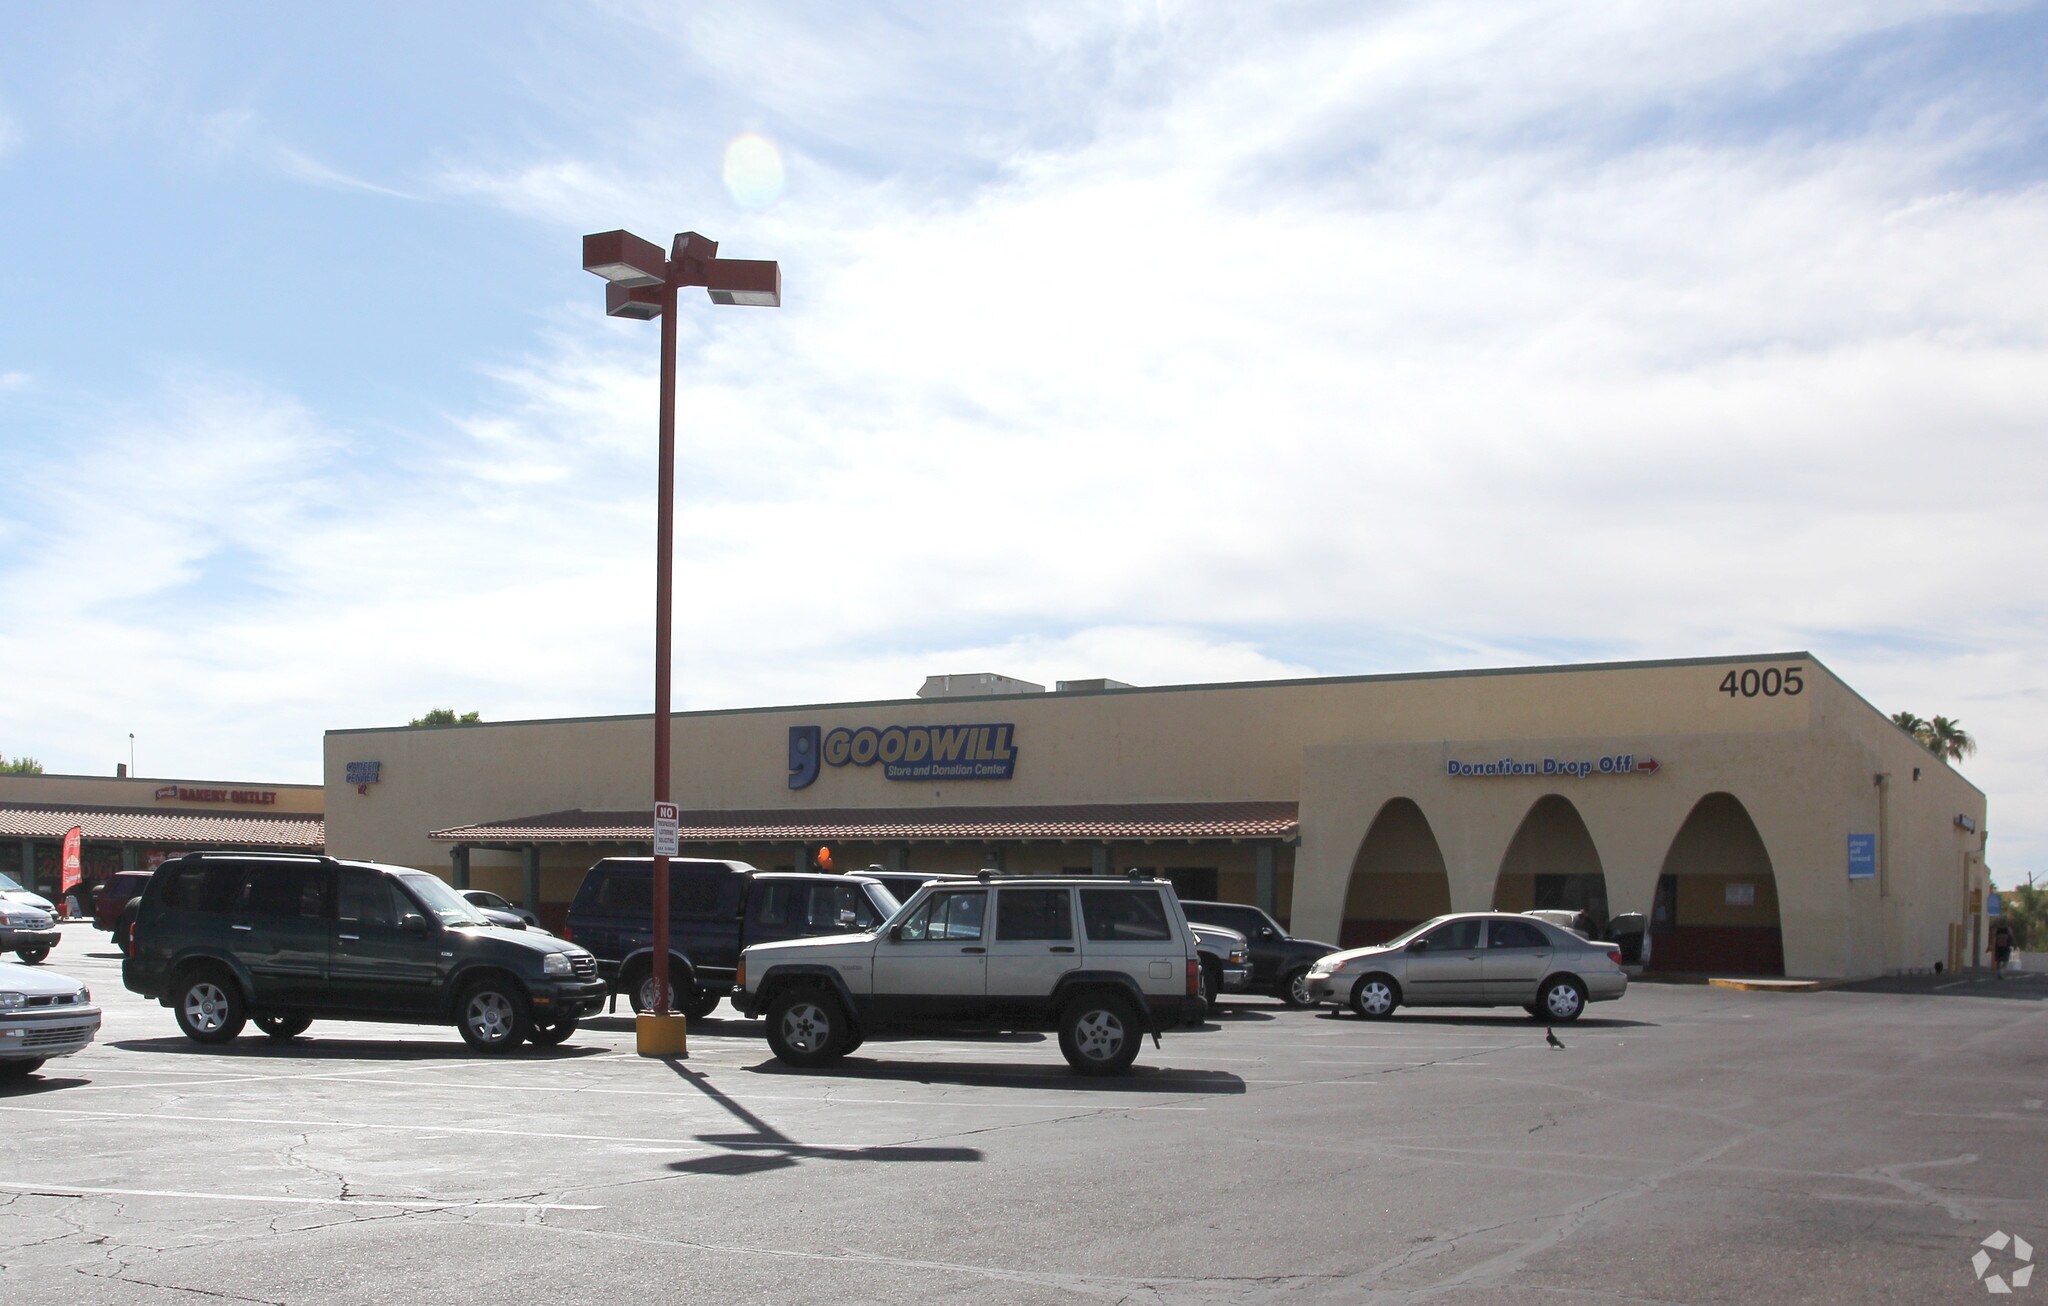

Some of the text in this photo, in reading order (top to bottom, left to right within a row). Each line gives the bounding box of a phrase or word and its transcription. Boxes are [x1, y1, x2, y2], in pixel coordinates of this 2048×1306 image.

[1718, 667, 1804, 698] 4005
[825, 727, 1012, 764] GOODWILL
[888, 763, 1007, 776] Store and Donation Center
[1448, 755, 1633, 778] Donation Drop Off
[179, 788, 227, 802] BAKERY
[231, 790, 277, 805] OUTLET
[660, 807, 673, 818] NO
